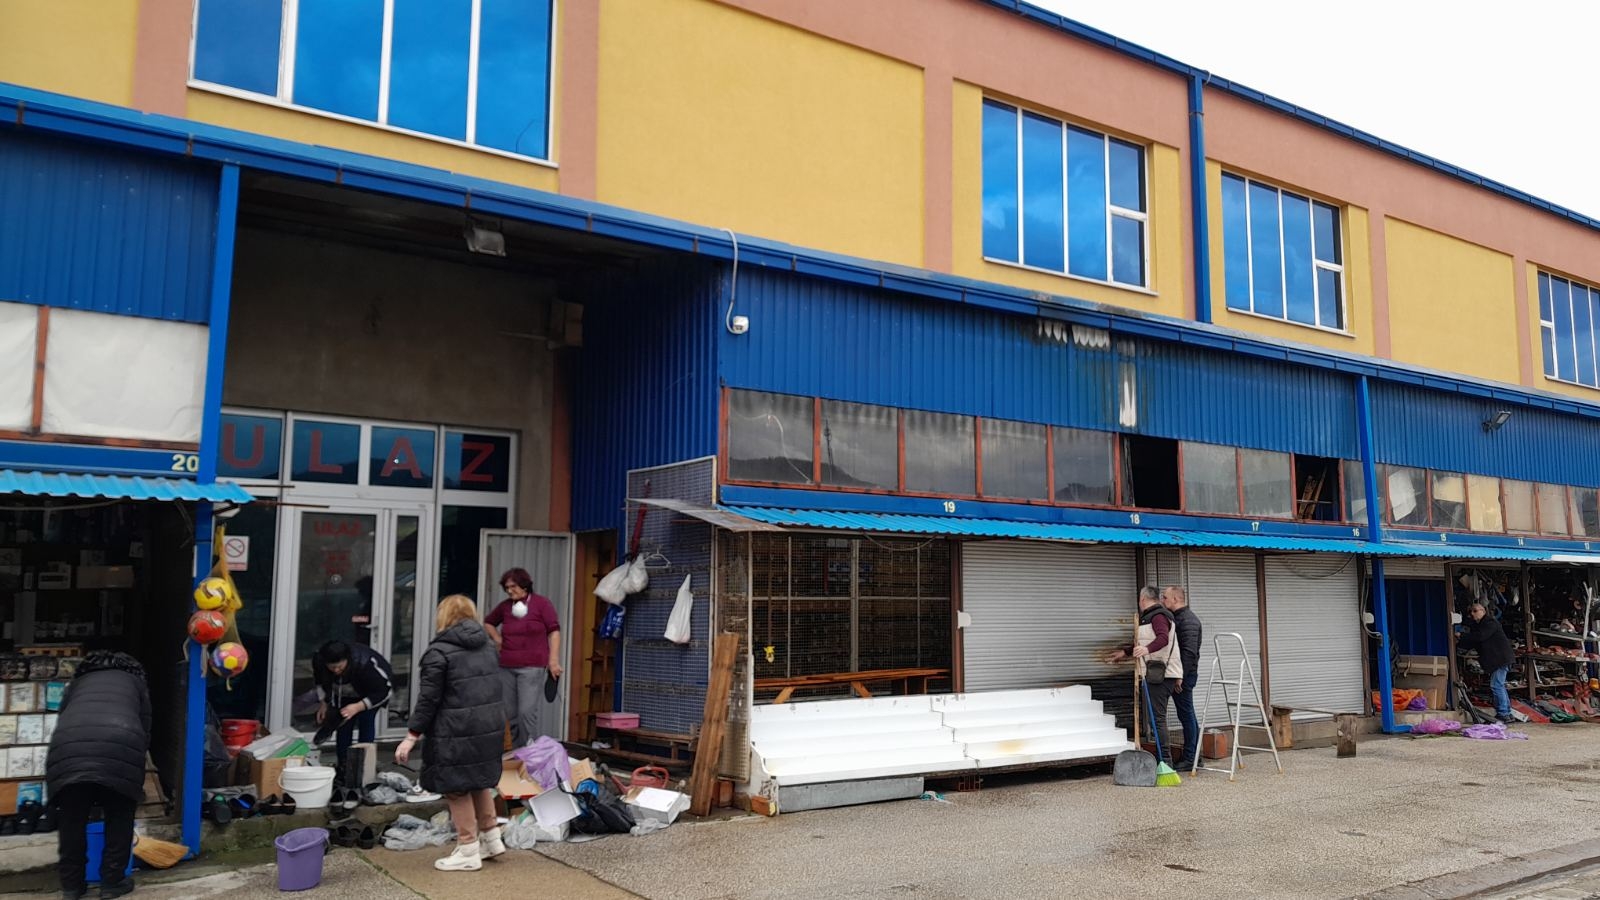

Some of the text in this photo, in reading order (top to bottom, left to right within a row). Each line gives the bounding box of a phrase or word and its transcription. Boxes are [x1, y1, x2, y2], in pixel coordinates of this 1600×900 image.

[222, 423, 495, 483] ULAZ
[171, 454, 200, 472] 20
[943, 501, 956, 513] 19
[1130, 514, 1140, 524] 18
[1251, 522, 1259, 531] 17
[1352, 528, 1360, 537] 16
[1440, 533, 1446, 541] 15
[1518, 538, 1524, 546] 14
